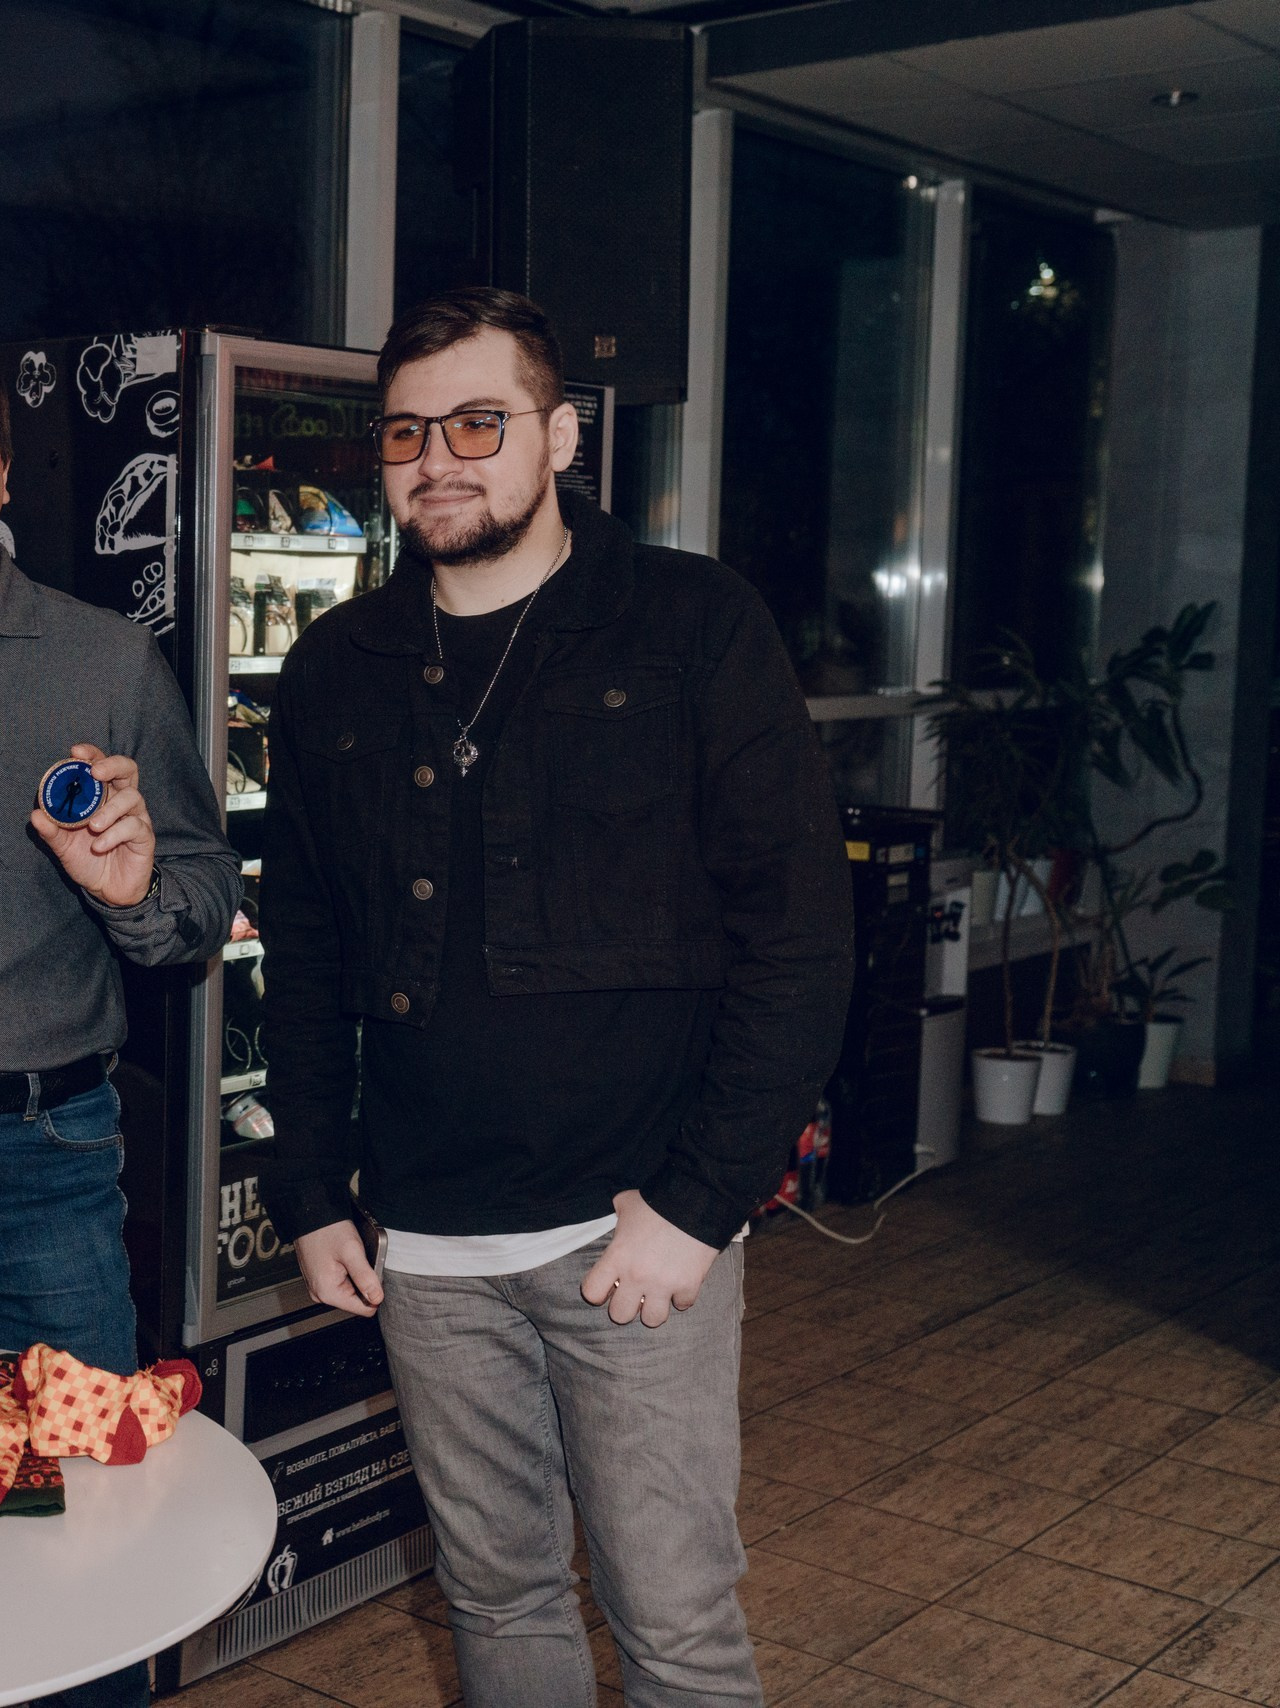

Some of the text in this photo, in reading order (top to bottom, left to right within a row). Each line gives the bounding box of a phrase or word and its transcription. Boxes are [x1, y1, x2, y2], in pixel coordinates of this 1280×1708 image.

[219, 1176, 268, 1229] HE
[277, 1482, 323, 1517] ВЕЖИЙ
[324, 1465, 370, 1497] ВЗГЛЯД
[371, 1459, 387, 1477] НА
[389, 1450, 410, 1469] СВЕ
